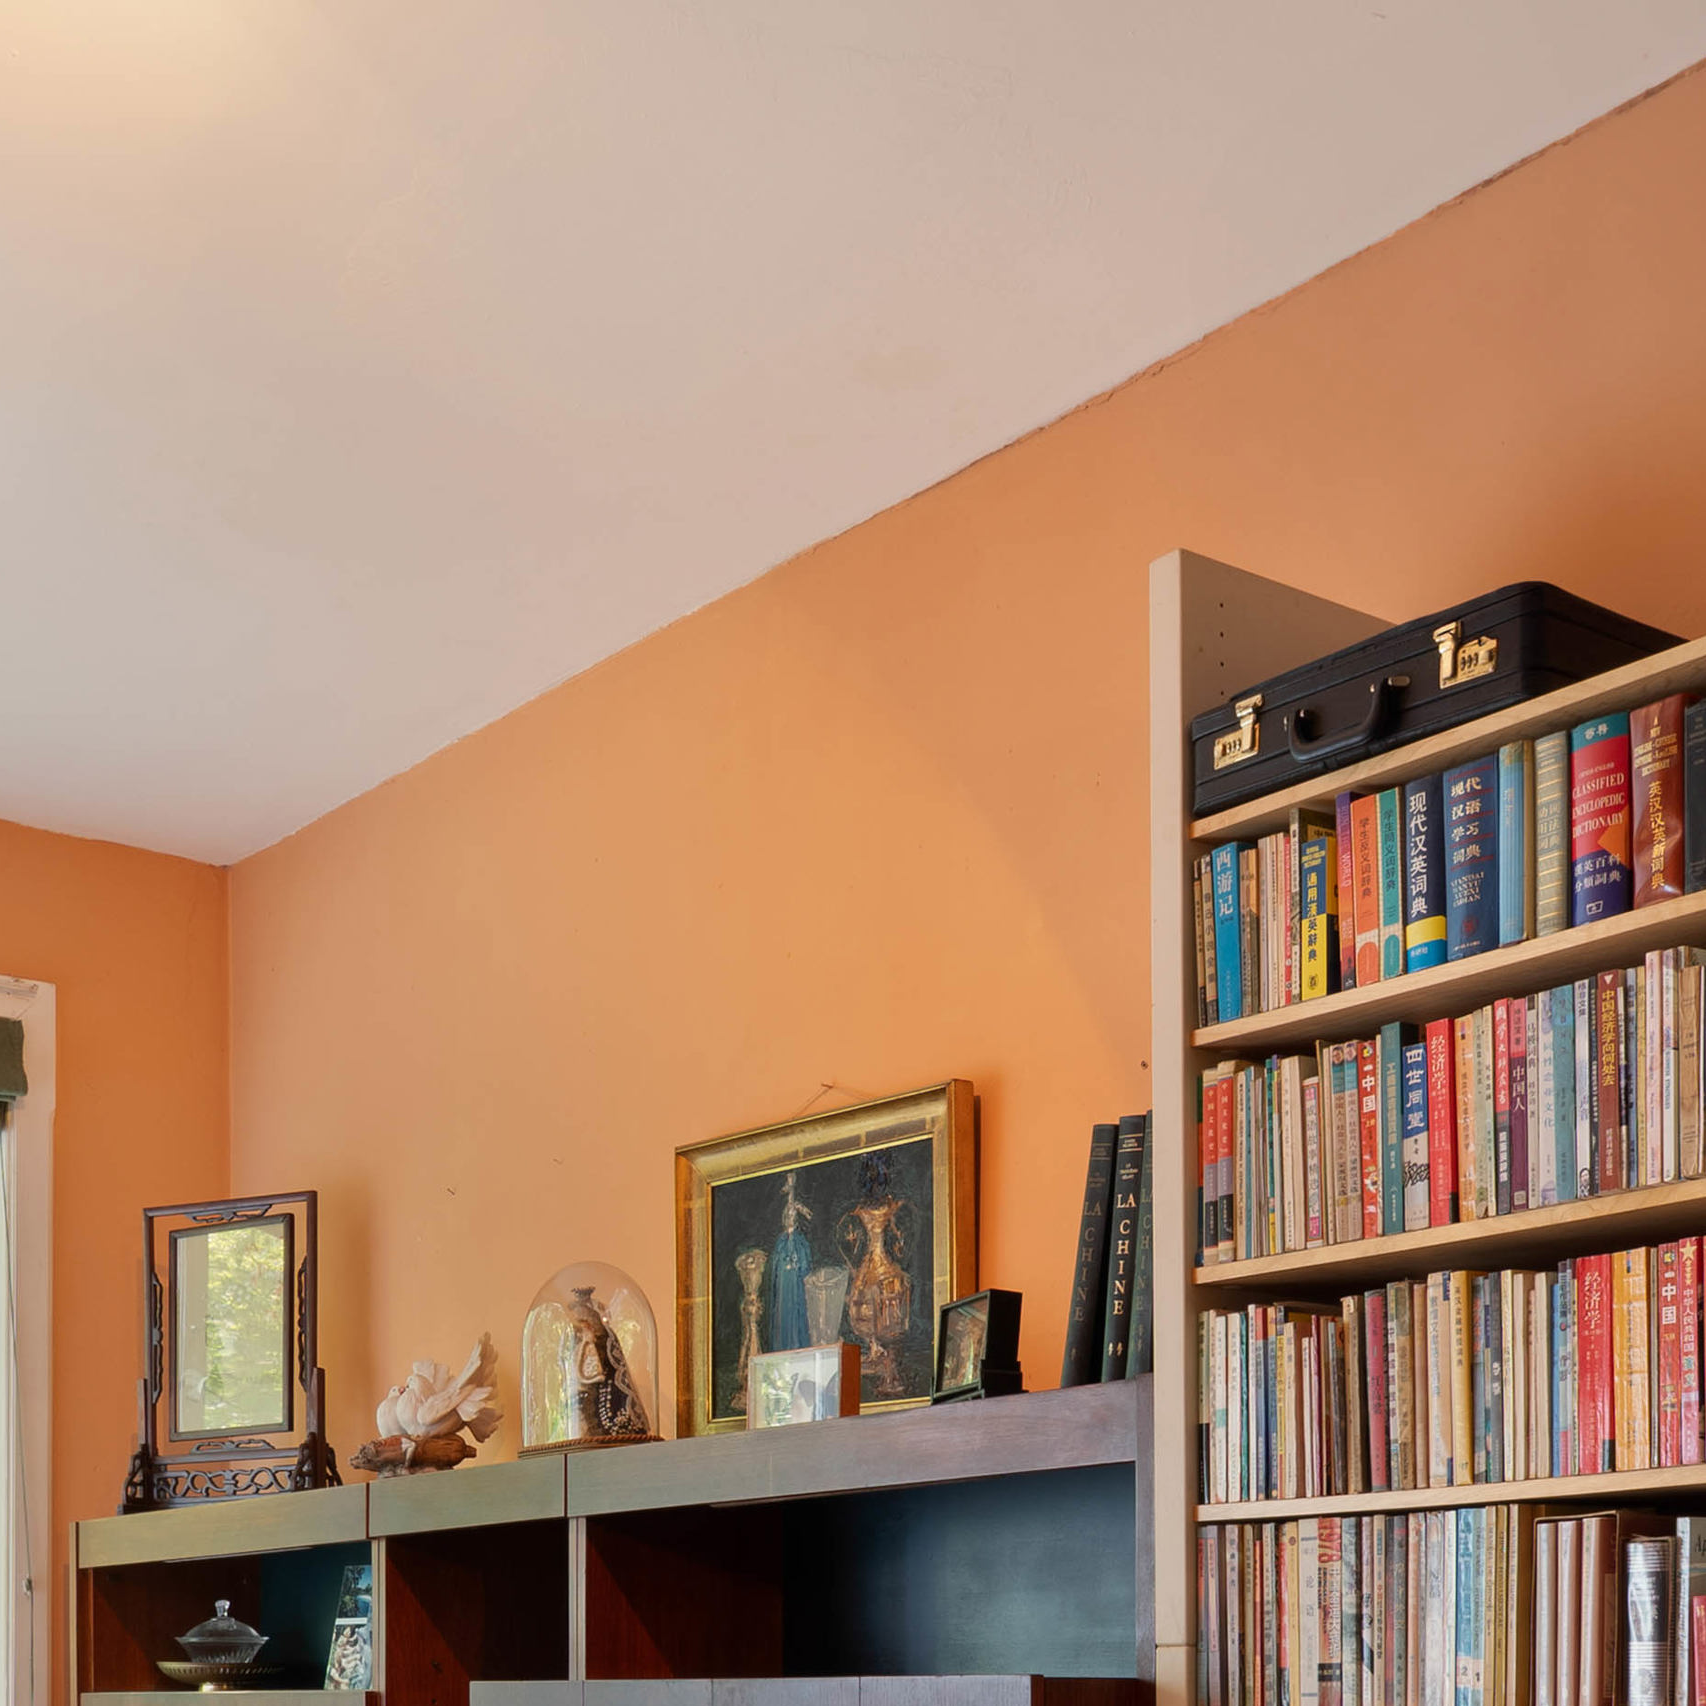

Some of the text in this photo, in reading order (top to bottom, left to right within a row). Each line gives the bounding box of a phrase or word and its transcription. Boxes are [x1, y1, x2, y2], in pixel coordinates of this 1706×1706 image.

[1450, 776, 1482, 799] 现代
[1572, 772, 1625, 800] CLASSIFIED
[1451, 798, 1482, 821] 汉语
[1573, 812, 1625, 839] DICTIONARY
[1451, 821, 1480, 842] 学习
[1408, 792, 1428, 918] 现代汉英词典
[1452, 844, 1481, 865] 词典
[1215, 849, 1234, 918] 西游记
[1601, 989, 1616, 1087] 中国经济学向何处去
[1405, 1048, 1425, 1131] 四世同堂
[1512, 1066, 1526, 1111] 中国人
[1113, 1193, 1137, 1316] LA CHINE
